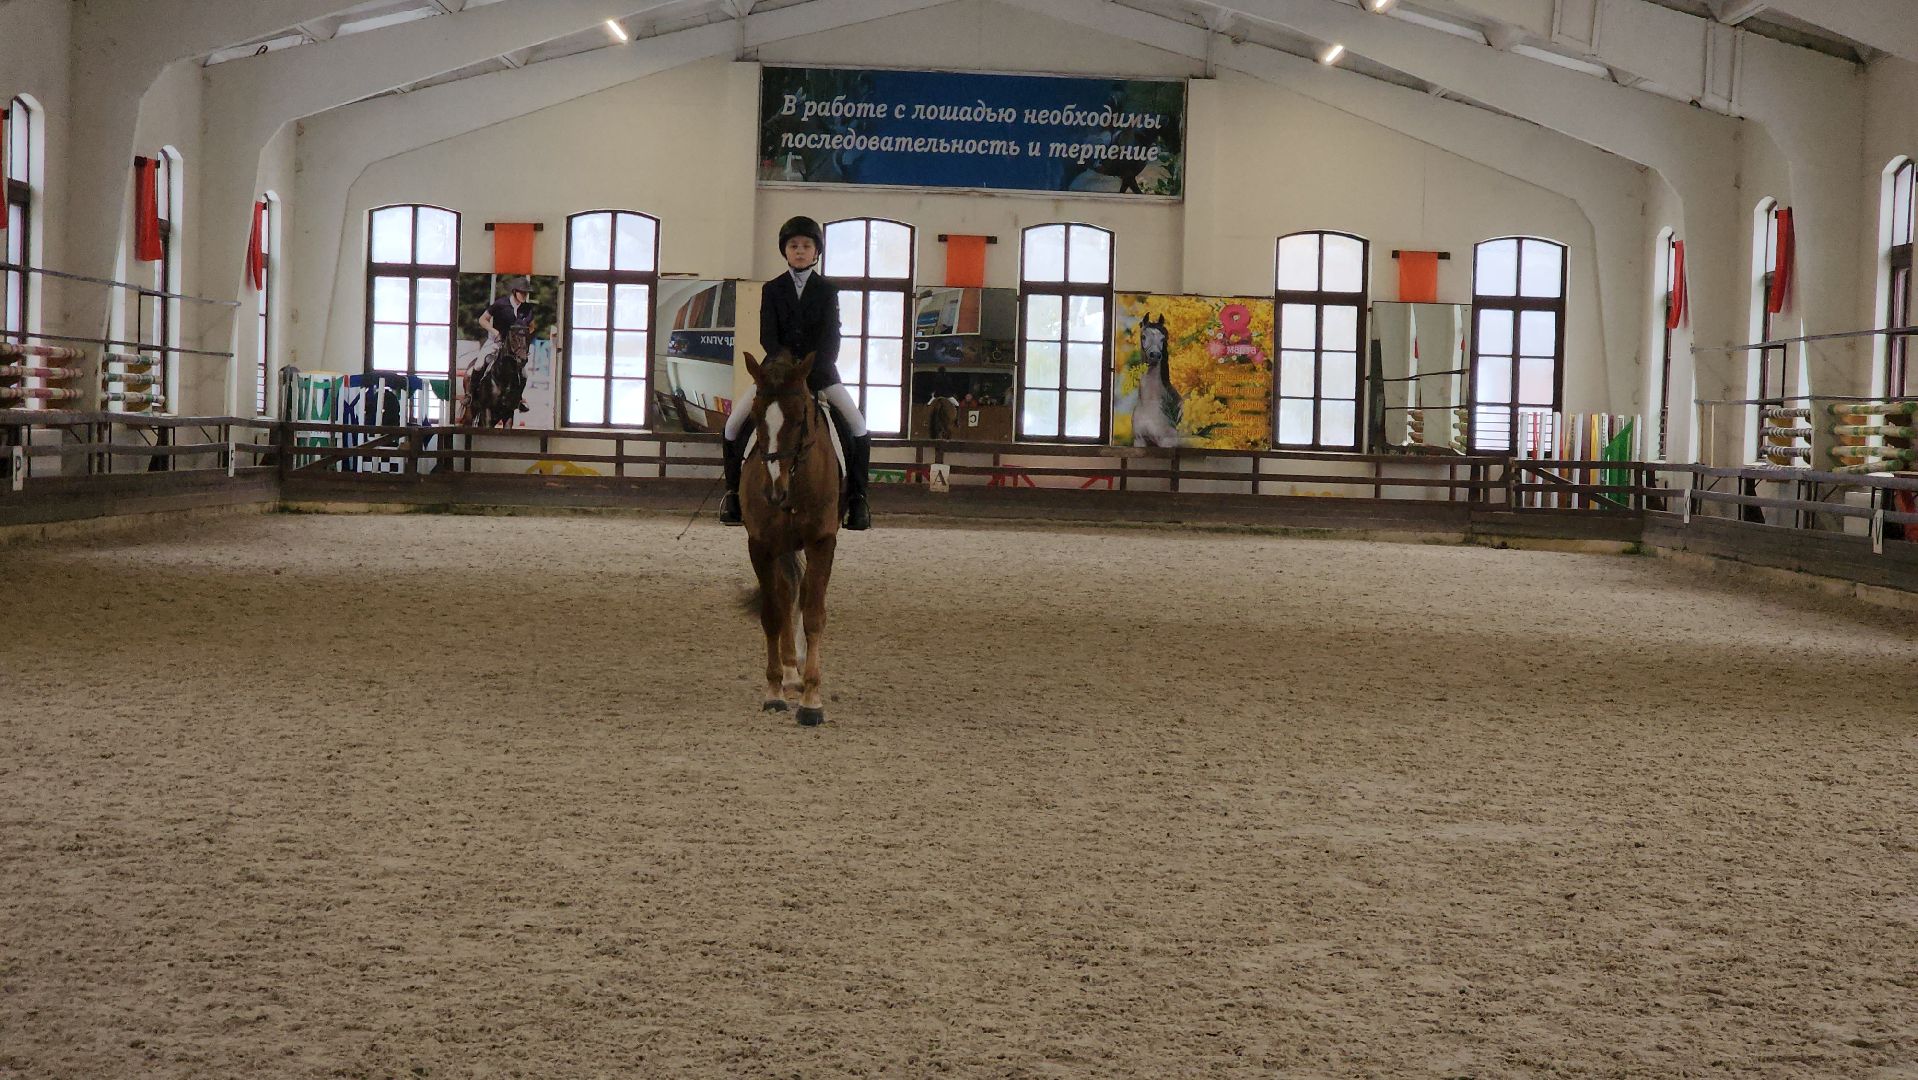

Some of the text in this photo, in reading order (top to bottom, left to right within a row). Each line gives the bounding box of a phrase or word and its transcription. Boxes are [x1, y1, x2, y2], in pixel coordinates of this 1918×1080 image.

[781, 94, 1162, 129] В работе с лошадью необходимы
[781, 127, 1159, 165] последовательность и терпение
[15, 455, 22, 482] P
[933, 469, 947, 486] A
